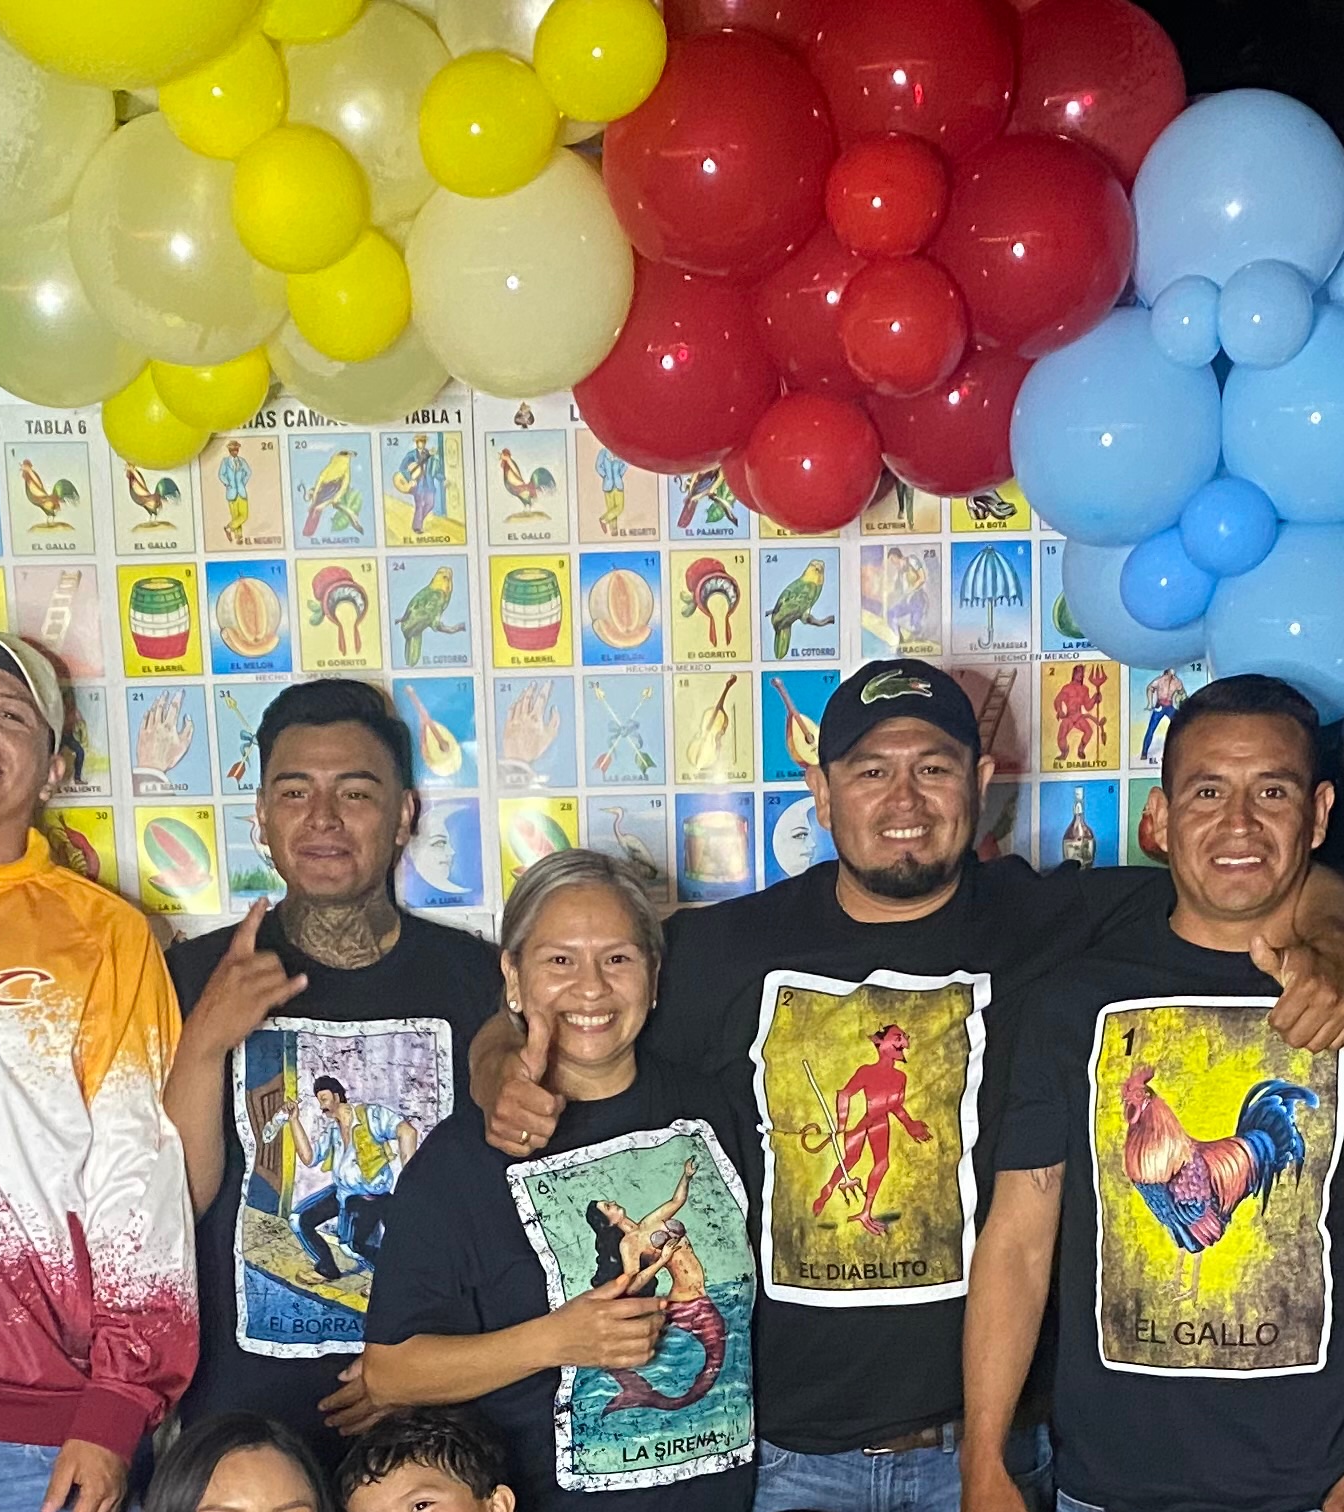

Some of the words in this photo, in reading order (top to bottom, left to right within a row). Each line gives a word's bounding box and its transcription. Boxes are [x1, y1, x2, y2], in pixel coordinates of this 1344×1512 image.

[455, 409, 462, 424] 1
[25, 420, 73, 435] TABLA
[78, 420, 87, 434] 6
[294, 440, 307, 449] 20
[386, 437, 399, 446] 32
[987, 521, 1008, 529] BOTA
[507, 533, 518, 541] EL
[521, 532, 551, 541] GALLO
[620, 529, 628, 537] EL
[696, 528, 734, 536] PAJARITO
[31, 543, 42, 551] EL
[45, 542, 76, 551] GALLO
[134, 543, 145, 551] EL
[147, 542, 177, 551] GALLO
[1046, 546, 1057, 555] 15
[645, 558, 655, 567] 11
[765, 554, 778, 563] 24
[271, 566, 281, 575] 11
[361, 564, 372, 572] 13
[393, 562, 405, 571] 24
[994, 653, 1027, 661] HECHO
[231, 662, 241, 670] EL
[1191, 664, 1202, 672] 12
[500, 683, 511, 692] 21
[132, 692, 144, 701] 21
[219, 690, 231, 698] 31
[1067, 760, 1107, 769] DIABLITO
[649, 800, 661, 809] 19
[768, 796, 781, 805] 23
[560, 802, 572, 811] 28
[95, 811, 108, 820] 30
[425, 897, 436, 905] LA
[782, 991, 794, 1007] 2
[1122, 1027, 1135, 1056] 1
[537, 1180, 551, 1195] 6
[799, 1262, 821, 1278] EL
[826, 1260, 928, 1281] DIABLITO
[269, 1315, 291, 1332] EL
[293, 1314, 364, 1334] BORRA
[1134, 1318, 1166, 1345] EL
[1173, 1321, 1280, 1347] GALLO
[622, 1445, 649, 1463] LA
[654, 1433, 719, 1461] SIRENA
